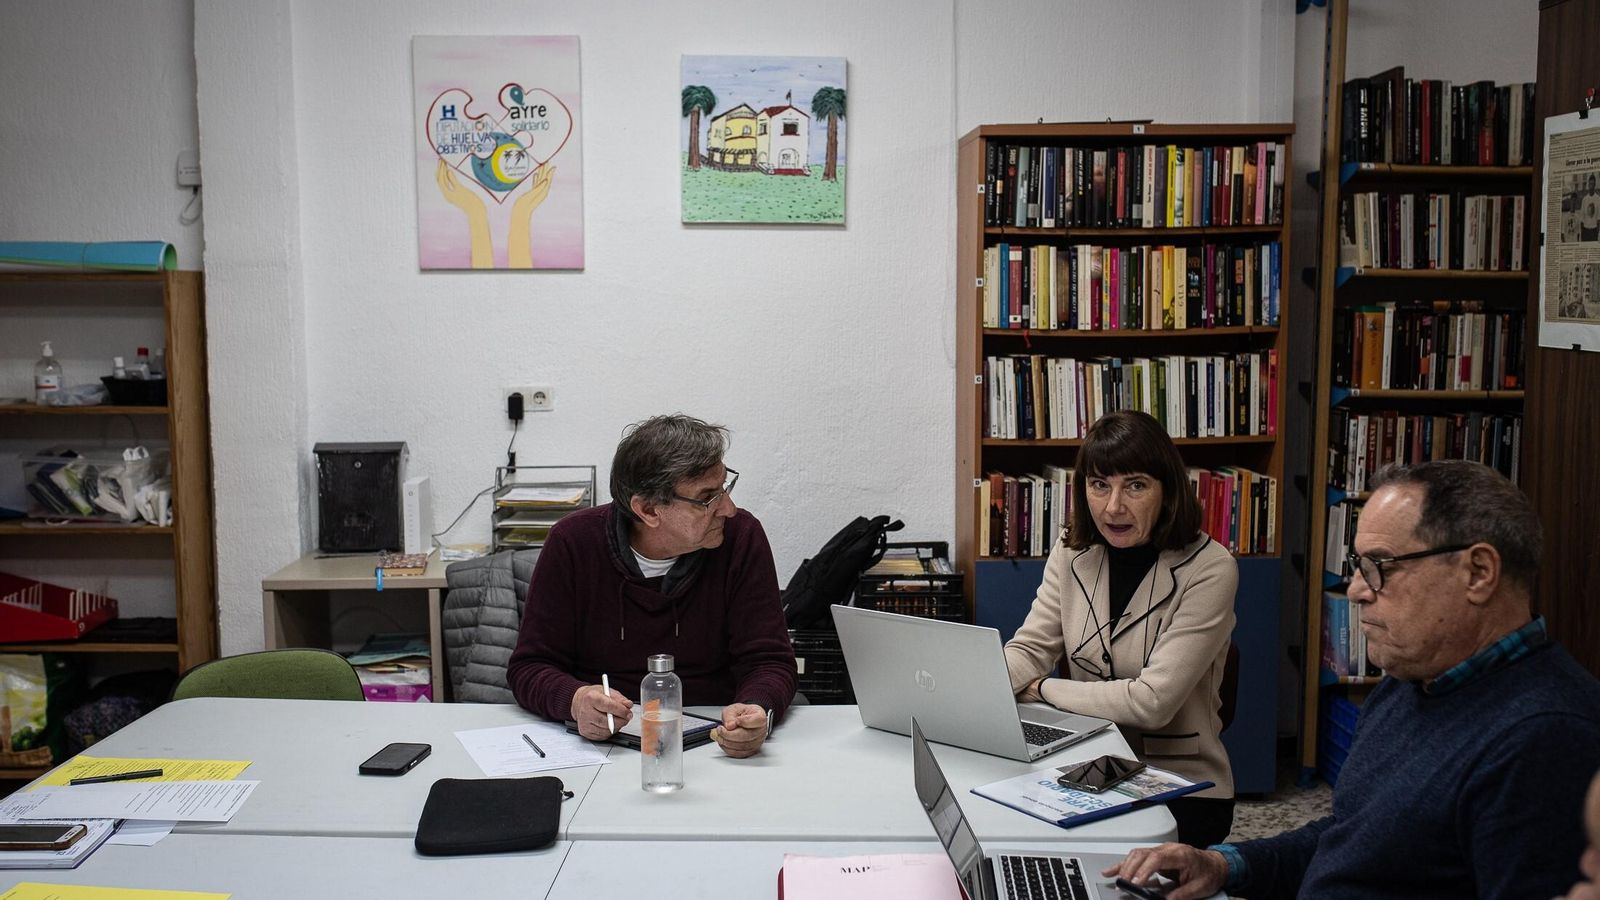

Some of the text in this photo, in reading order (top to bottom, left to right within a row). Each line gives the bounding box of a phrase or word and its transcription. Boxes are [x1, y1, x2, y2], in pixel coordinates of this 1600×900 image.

[442, 105, 455, 117] H
[511, 120, 550, 132] solidario
[451, 132, 492, 144] HUELVA
[1058, 796, 1100, 811] AYRE
[840, 866, 871, 874] MAP
